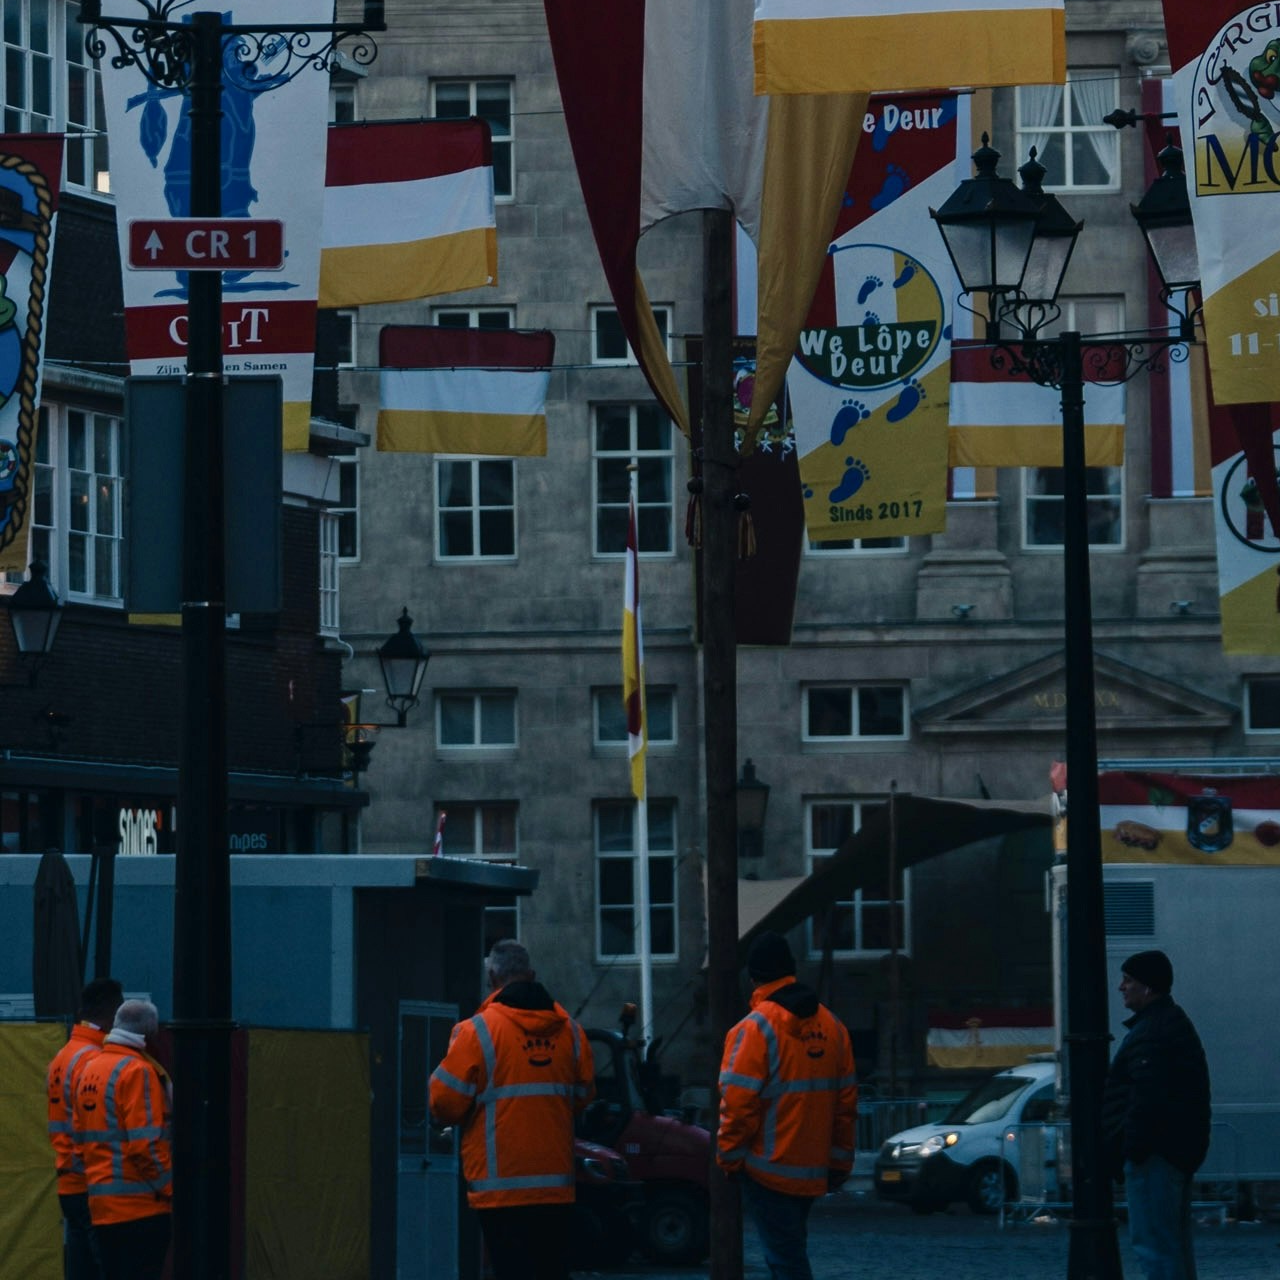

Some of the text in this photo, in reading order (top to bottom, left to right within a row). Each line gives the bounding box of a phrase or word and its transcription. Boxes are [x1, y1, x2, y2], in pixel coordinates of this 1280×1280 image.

[883, 104, 944, 132] Deur
[185, 229, 257, 259] CR 1
[799, 325, 931, 356] We Lôpe
[156, 364, 181, 376] Zijn
[243, 361, 288, 372] Samen
[829, 352, 904, 378] Deur
[878, 500, 923, 520] 2017
[229, 832, 268, 852] nipes
